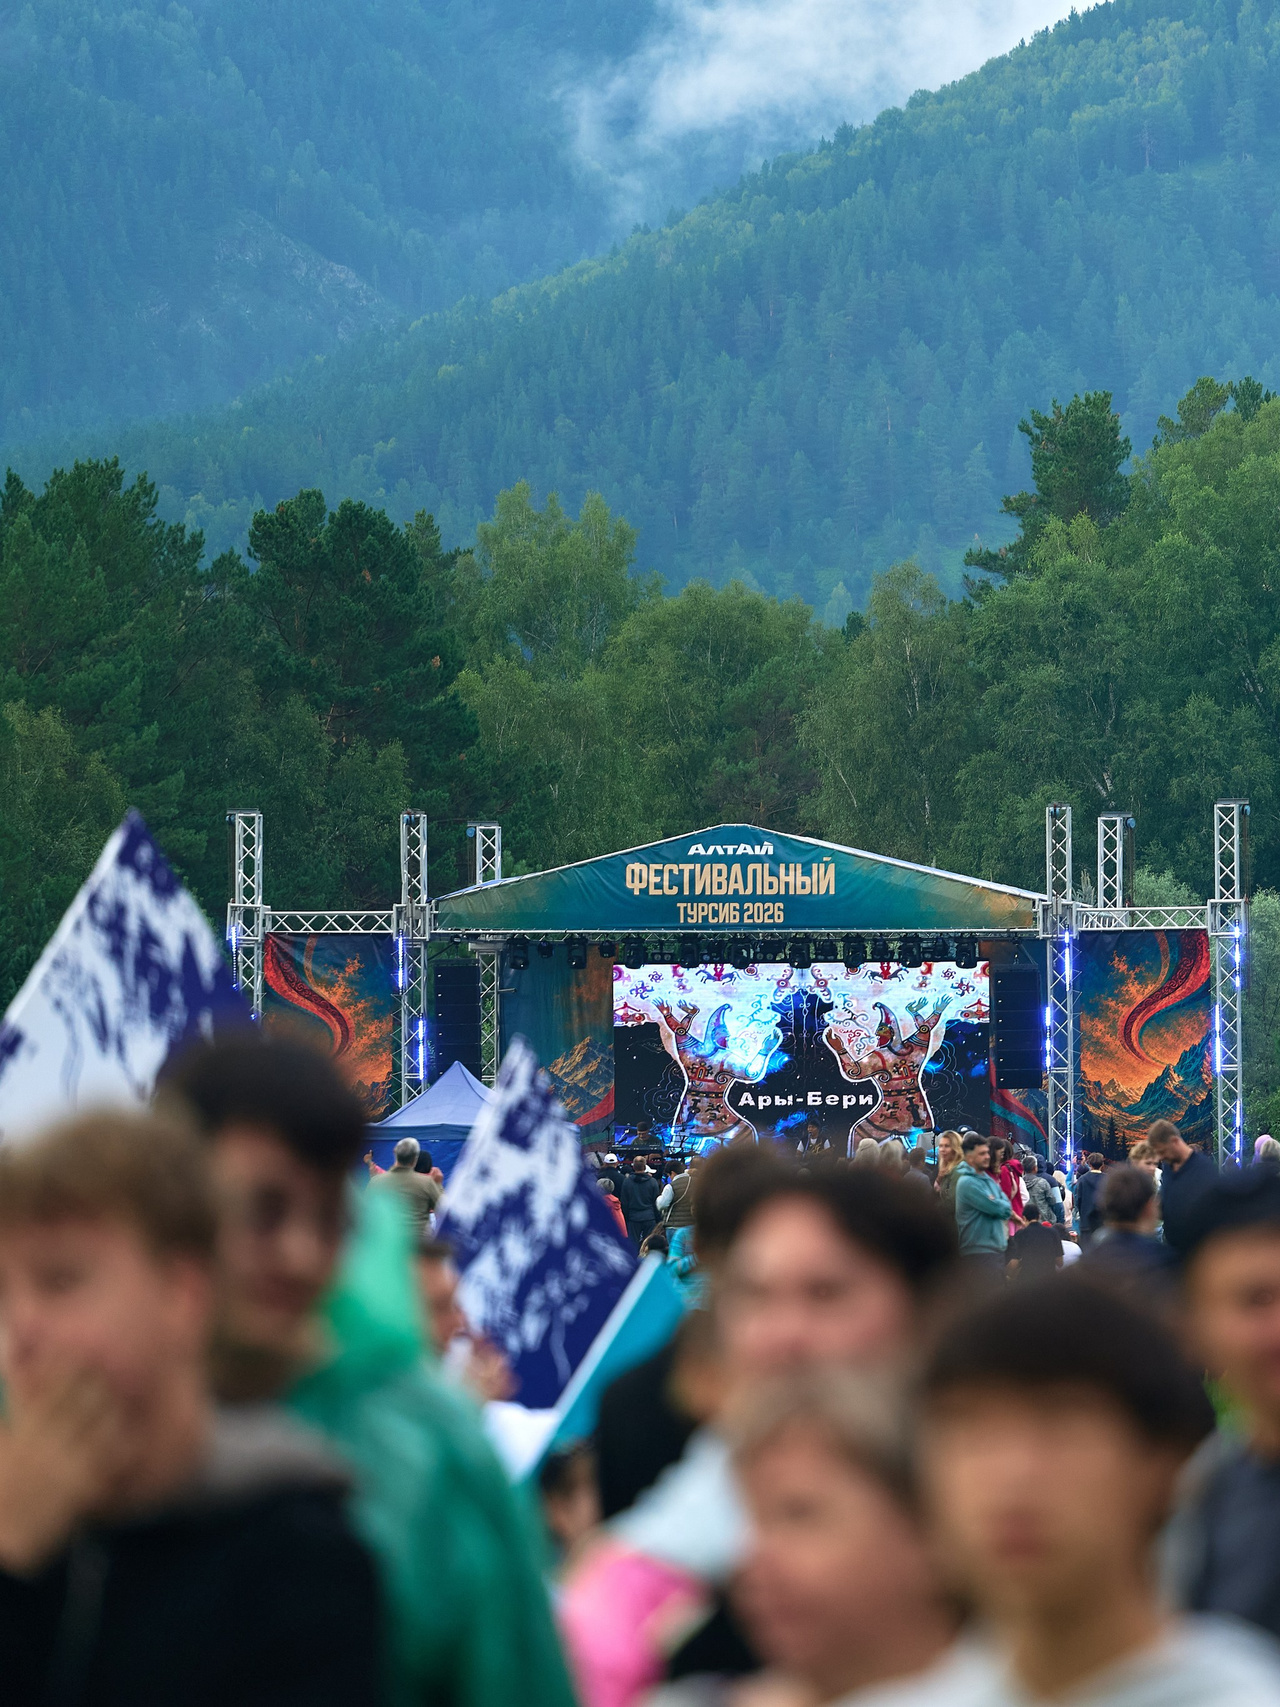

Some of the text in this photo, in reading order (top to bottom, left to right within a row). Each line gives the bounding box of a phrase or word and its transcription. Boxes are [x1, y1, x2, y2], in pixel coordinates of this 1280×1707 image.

[687, 841, 774, 856] АЛТАЙ
[625, 857, 836, 896] ФЕСТИВАЛЬНЫЙ
[676, 902, 784, 924] ТУРСИБ 2026
[738, 1091, 874, 1110] Ары-Бери
